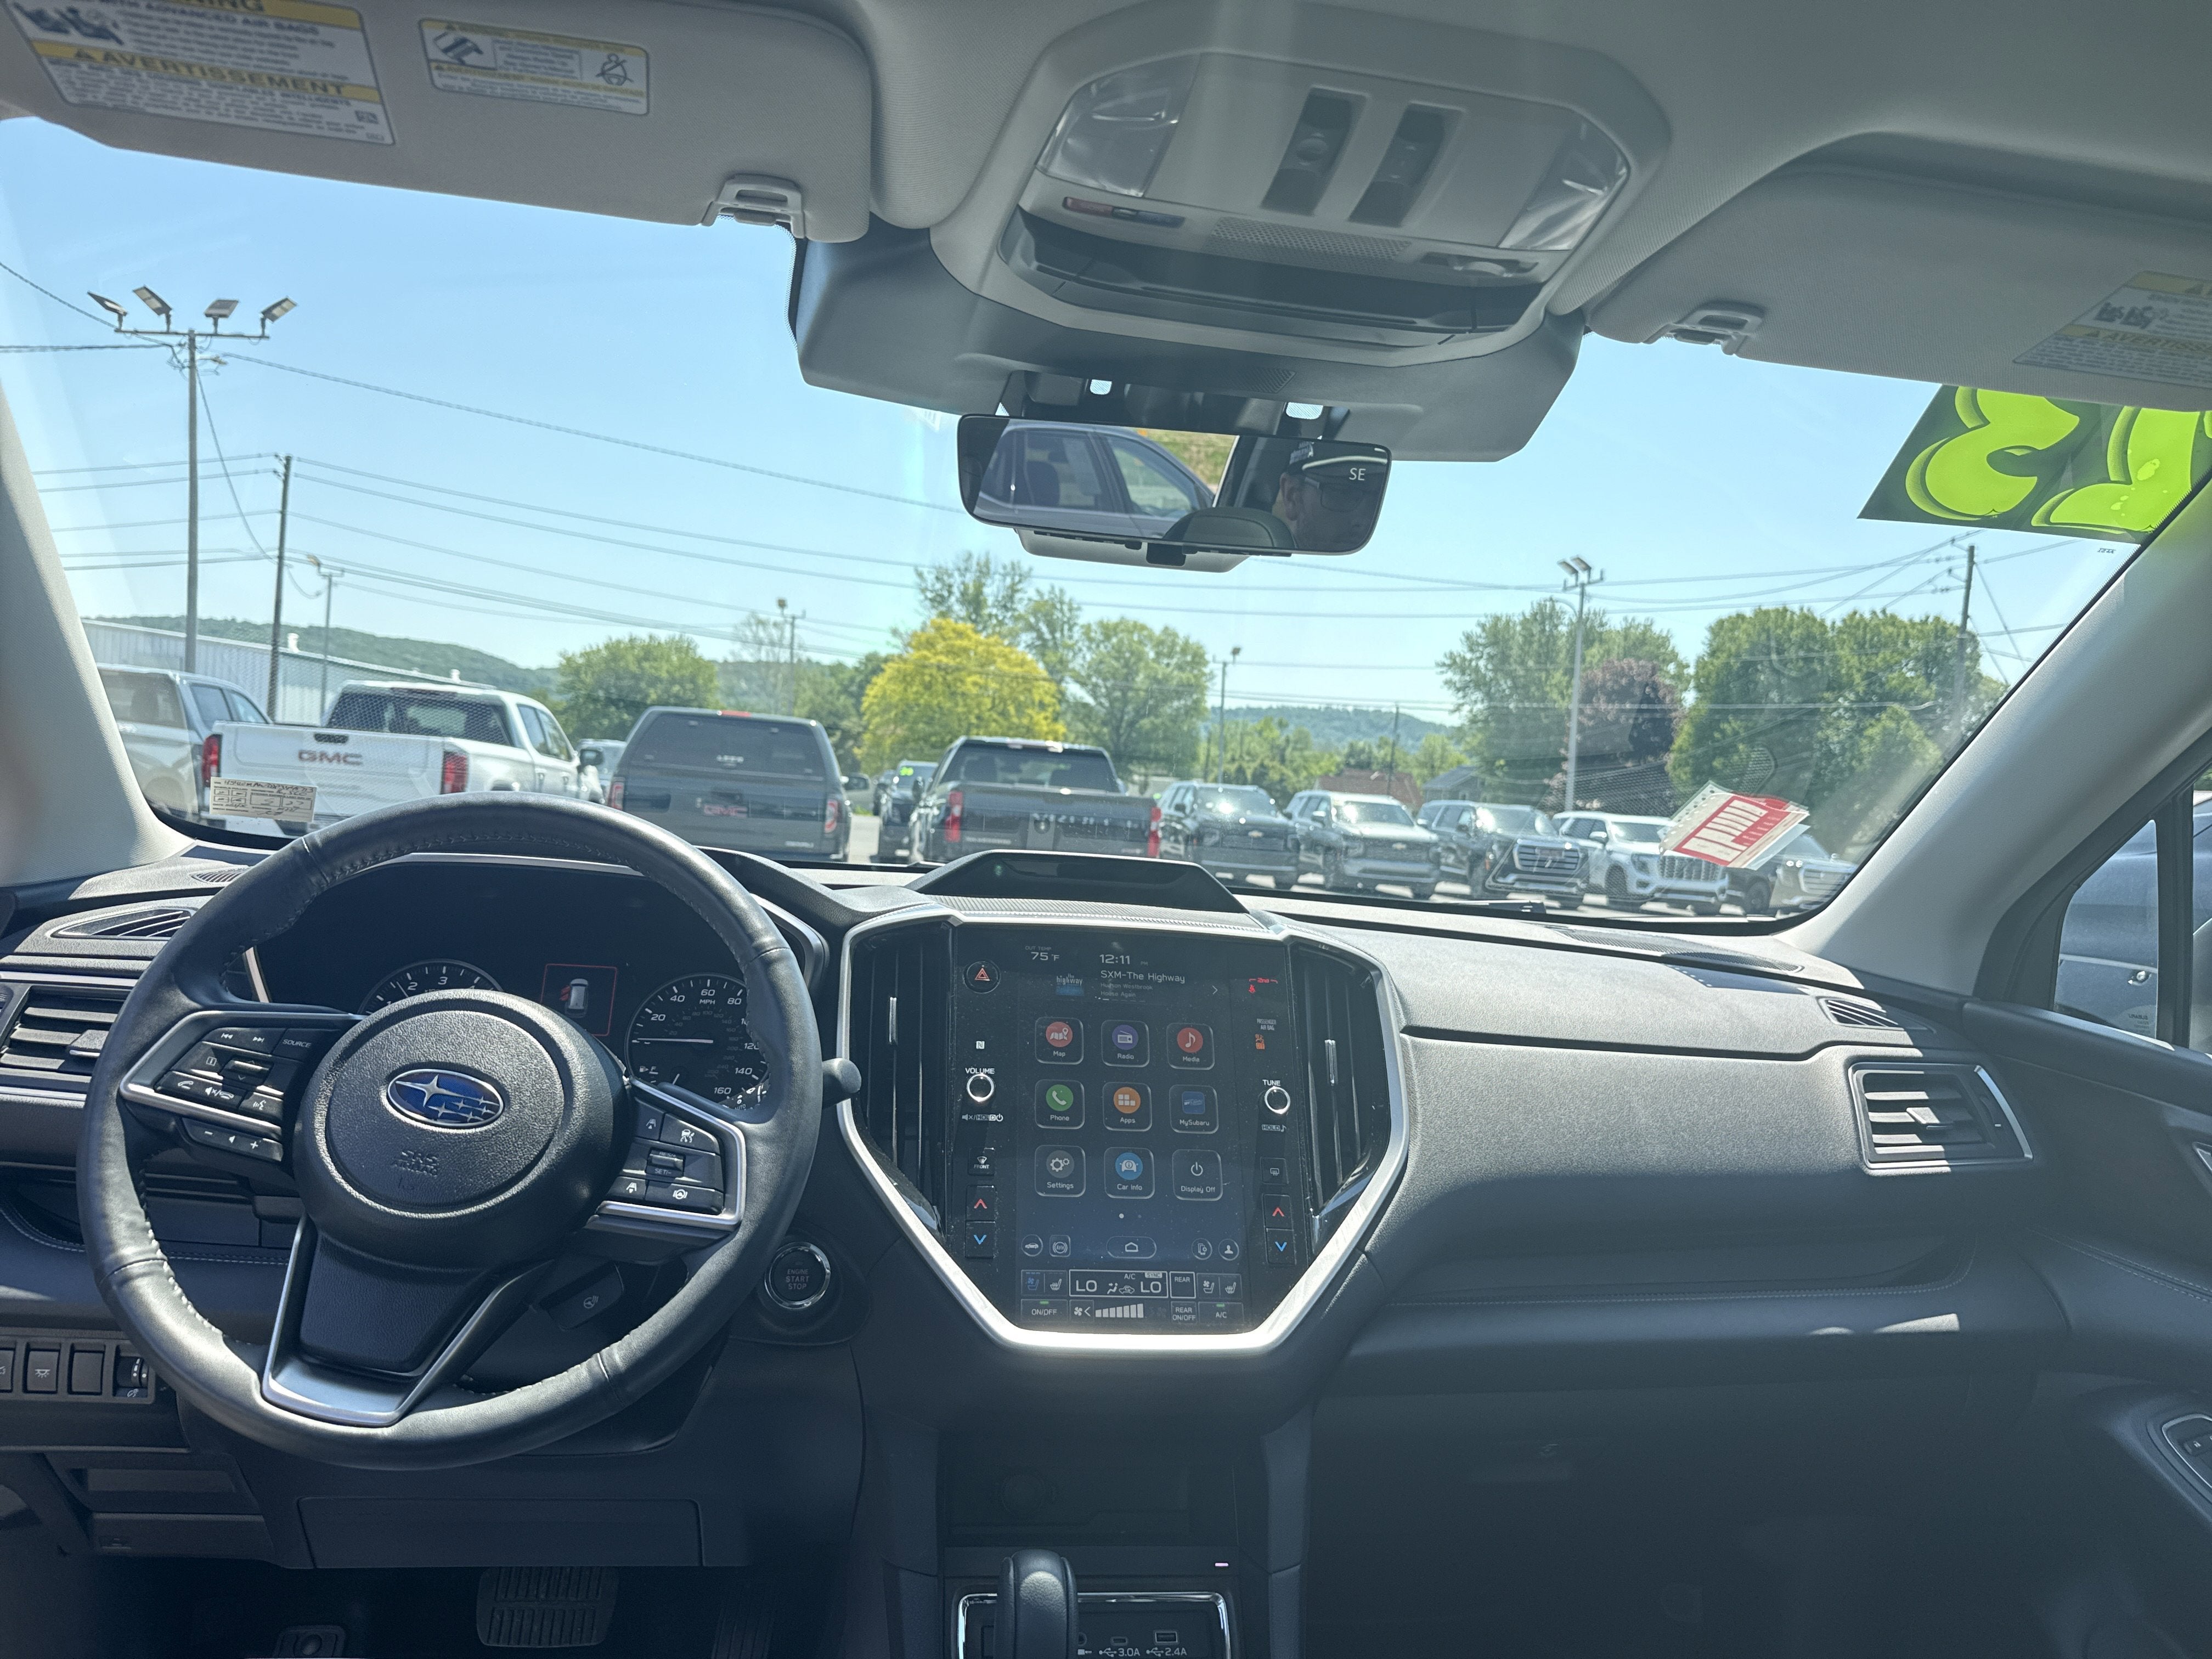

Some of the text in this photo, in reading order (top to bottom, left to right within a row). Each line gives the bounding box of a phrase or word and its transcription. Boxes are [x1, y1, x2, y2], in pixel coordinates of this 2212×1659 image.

[103, 50, 345, 97] AVERTISSEMENT
[1348, 467, 1366, 481] SE
[298, 749, 363, 766] GMC
[703, 803, 748, 818] GMC
[1030, 952, 1049, 961] 75
[1099, 953, 1131, 965] 12:11
[437, 976, 448, 985] 3
[1056, 975, 1084, 985] highway
[1100, 970, 1186, 984] SXM-The Highway
[408, 981, 418, 991] 2
[701, 989, 715, 997] 60
[670, 995, 685, 1003] 40
[727, 997, 742, 1006] 80
[651, 1013, 666, 1022] 20
[283, 1039, 312, 1048] SOURCE
[1052, 1050, 1066, 1059] Map
[1049, 1114, 1070, 1122] Phone
[1119, 1116, 1136, 1126] Apps
[1179, 1119, 1210, 1127] MySubaru
[1046, 1181, 1075, 1190] Settings
[1116, 1183, 1143, 1191] Car Info
[1180, 1185, 1216, 1195] Display Off
[1075, 1280, 1098, 1293] LO
[1140, 1281, 1162, 1294] LO
[1031, 1308, 1058, 1316] ON/OFF
[1172, 1313, 1196, 1322] ON/OFF
[1118, 1647, 1141, 1657] 3.0A
[1164, 1647, 1187, 1656] 2.4A
